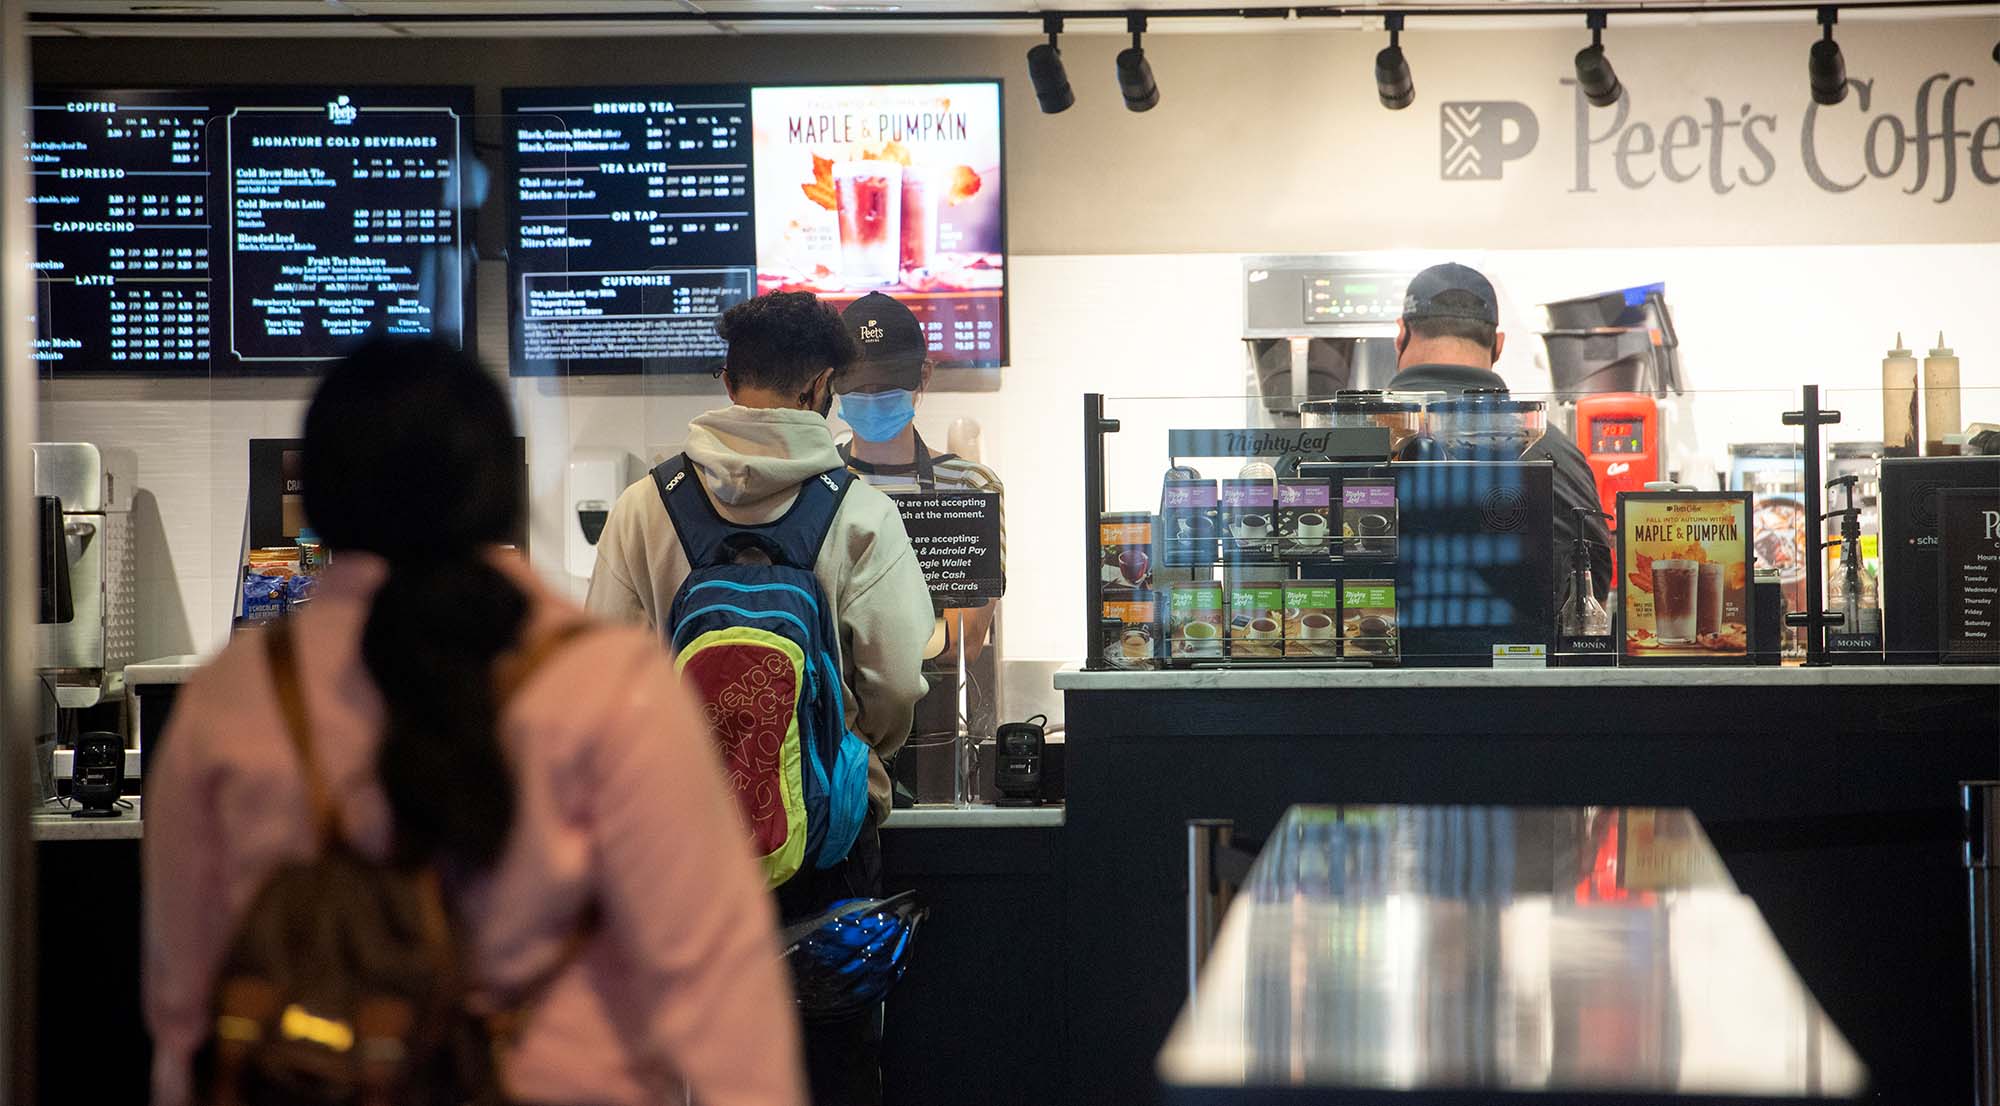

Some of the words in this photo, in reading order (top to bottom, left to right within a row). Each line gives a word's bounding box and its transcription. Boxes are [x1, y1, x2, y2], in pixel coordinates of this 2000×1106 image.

[67, 103, 117, 112] COFFEE
[593, 103, 646, 114] BREWED
[650, 102, 675, 113] TEA
[789, 114, 854, 143] MAPLE
[879, 112, 967, 142] PUMPKIN
[252, 136, 322, 147] SIGNATURE
[327, 136, 360, 147] COLD
[364, 136, 438, 147] BEVERAGES
[61, 168, 125, 178] ESPRESSO
[236, 168, 257, 178] Cold
[259, 168, 282, 178] Brew
[283, 168, 309, 178] Black
[601, 163, 625, 173] TEA
[628, 163, 667, 173] LATTE
[236, 200, 257, 209] Cold
[259, 200, 282, 209] Brew
[284, 200, 300, 209] Oat
[302, 200, 326, 209] Latte
[611, 211, 630, 221] ON
[634, 211, 658, 221] TAP
[53, 222, 135, 232] CAPPUCCINO
[520, 225, 541, 235] Cold
[543, 225, 567, 235] Brew
[238, 233, 274, 243] Blended
[521, 238, 548, 248] Nitro
[549, 238, 567, 247] Cold
[567, 238, 592, 247] Brew
[307, 256, 331, 266] Fruit
[332, 256, 348, 266] Tea
[350, 256, 386, 266] Shakers
[76, 275, 115, 285] LATTE
[602, 276, 671, 286] CUSTOMIZE
[860, 326, 884, 340] Peet's
[1225, 432, 1290, 454] Mighty
[1290, 431, 1333, 453] Leaf
[923, 499, 939, 507] not
[941, 498, 986, 508] accepting
[915, 511, 924, 519] at
[926, 511, 941, 519] the
[944, 511, 985, 519] moment.
[1635, 525, 1673, 542] MAPLE
[1676, 528, 1684, 540] &
[1686, 525, 1737, 541] PUMPKIN
[932, 535, 979, 544] accepting:
[920, 547, 927, 555] &
[929, 546, 966, 555] Android
[968, 546, 987, 556] Pay
[942, 559, 972, 567] Wallet
[942, 571, 966, 579] Cash
[928, 583, 949, 591] redit
[951, 583, 978, 591] Cards
[1572, 641, 1606, 649] MONIN
